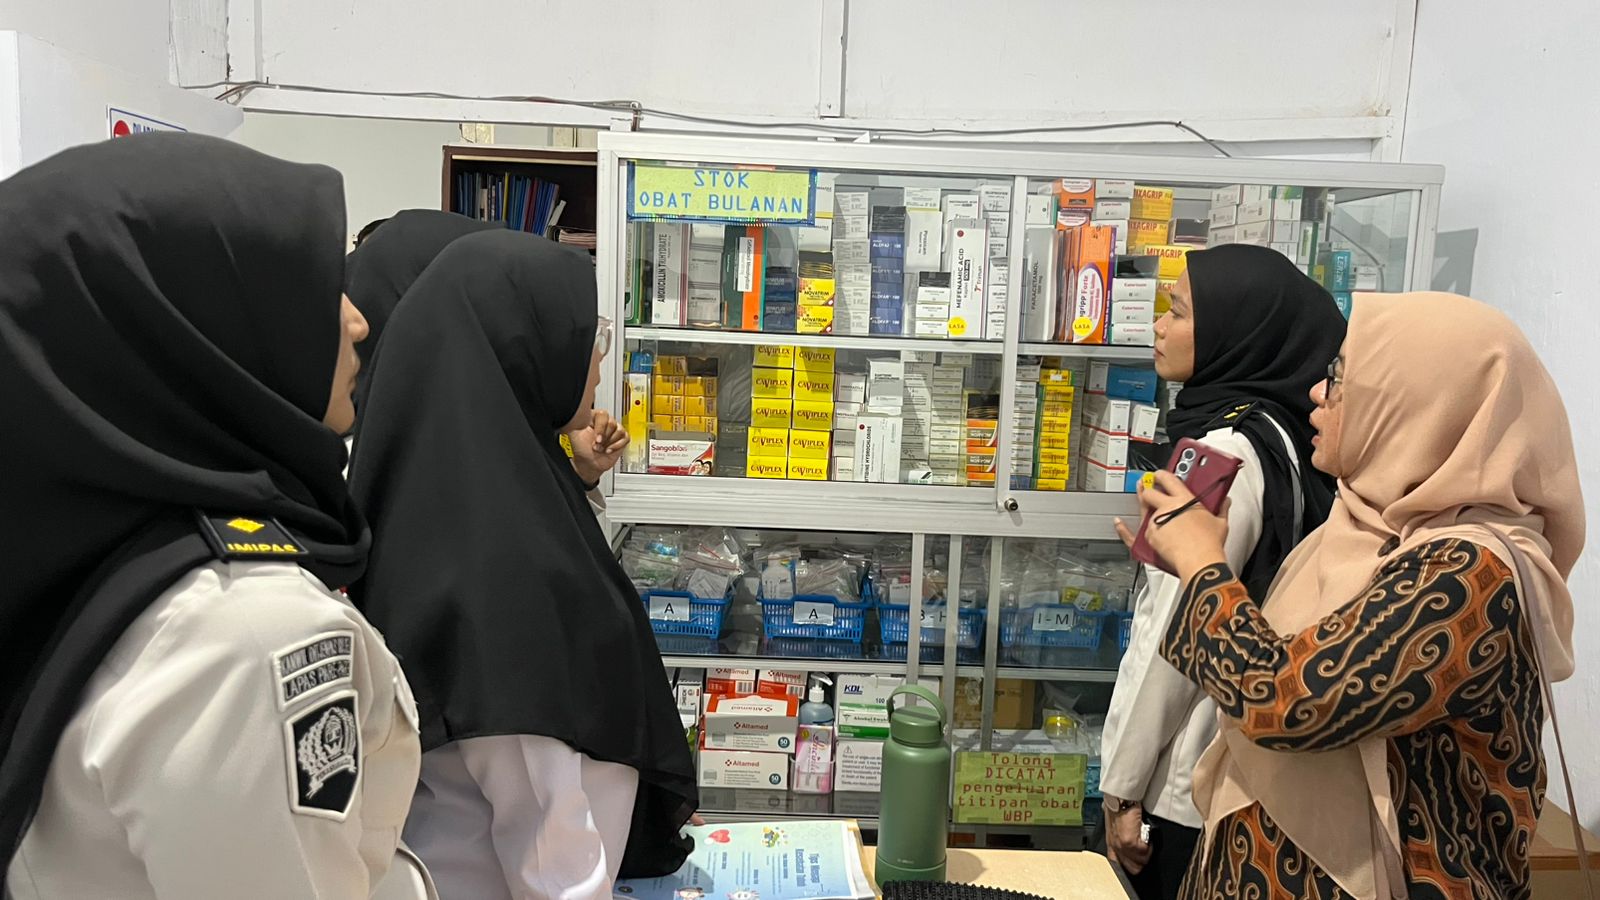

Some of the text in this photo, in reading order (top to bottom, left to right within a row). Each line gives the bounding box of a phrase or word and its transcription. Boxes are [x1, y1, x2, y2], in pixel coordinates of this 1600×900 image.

[694, 170, 749, 188] STOK
[640, 192, 802, 213] OBAT BULANAN
[1130, 222, 1157, 232] IXAGRIP
[1146, 248, 1182, 258] MIXAGRIP
[657, 234, 668, 303] AMOXICILLIN TRIHYDRATE
[799, 352, 830, 361] CAVIPLEX
[756, 378, 788, 388] CAVIPLEX
[798, 381, 830, 390] CAVIPLEX
[756, 408, 788, 417] CAVIPLEX
[797, 410, 829, 420] CAVIPLEX
[651, 444, 687, 452] Sangobion
[794, 438, 824, 448] CAVIPLEX
[750, 464, 782, 474] CAVIPLEX
[792, 466, 823, 476] CAVIPLEX
[227, 544, 298, 552] IMIPAS
[664, 603, 674, 614] A
[808, 608, 818, 620] A
[1056, 612, 1069, 625] M
[283, 670, 318, 700] LAPAS
[844, 684, 863, 693] KDL
[991, 753, 1052, 768] Tolong
[985, 767, 1056, 780] DICATAT
[963, 783, 1076, 796] pengeluaran
[959, 796, 1080, 810] titipan obat
[1003, 810, 1033, 822] WBP
